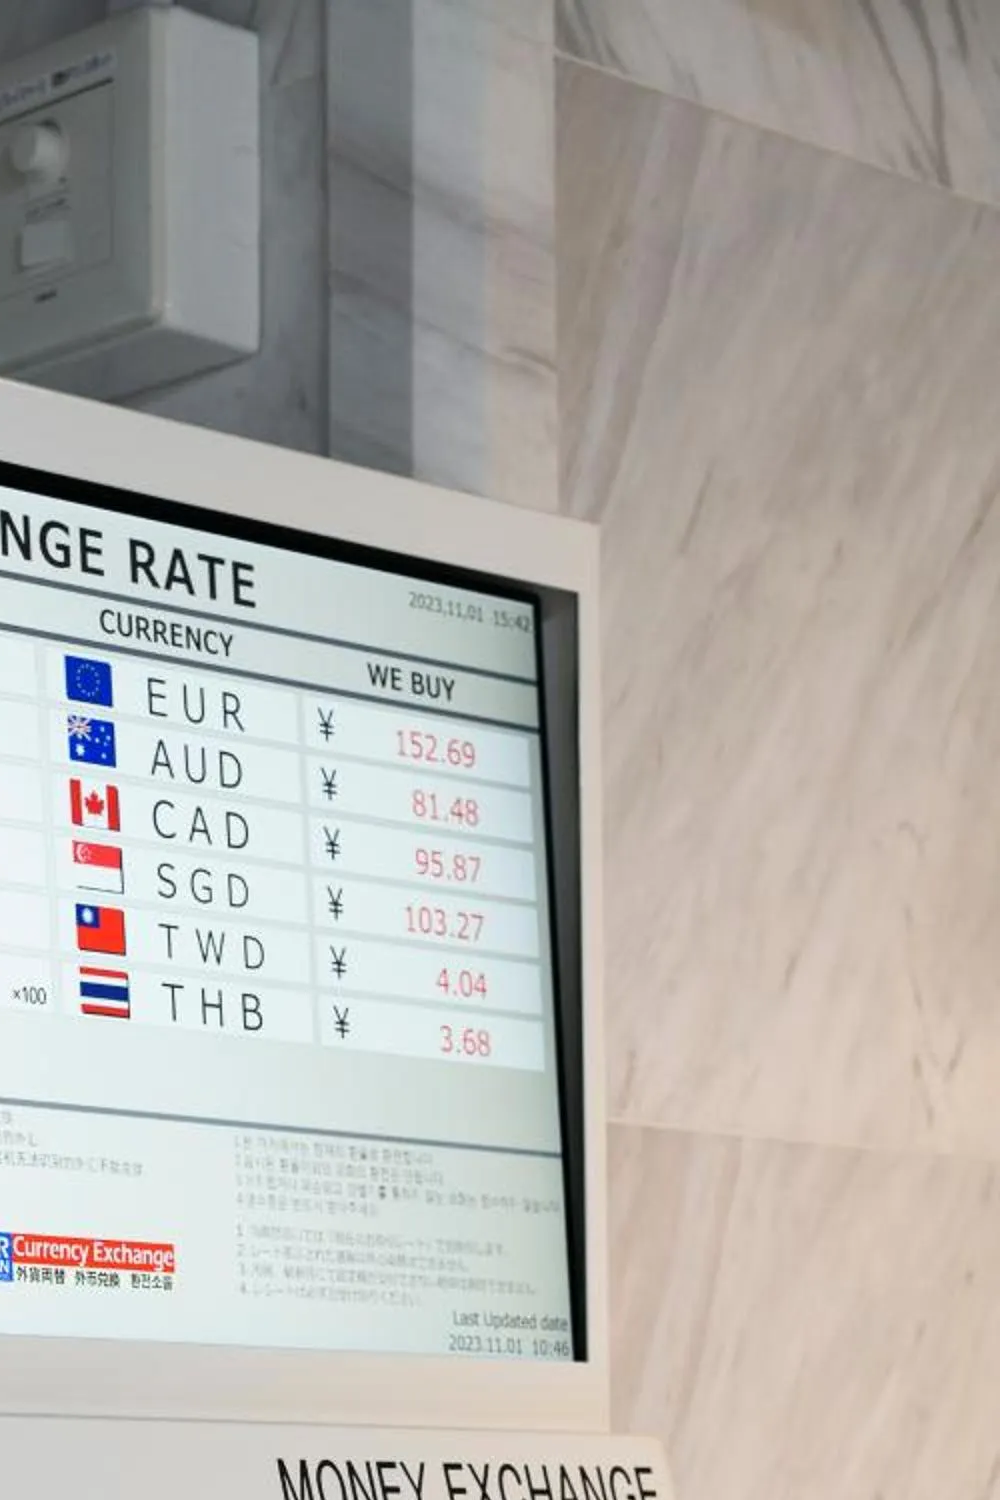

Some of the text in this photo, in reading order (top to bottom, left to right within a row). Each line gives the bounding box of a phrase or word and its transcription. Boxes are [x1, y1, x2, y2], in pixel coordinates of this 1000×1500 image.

[129, 538, 256, 608] RATE
[99, 609, 234, 657] CURRENCY
[367, 661, 455, 702] WE BUY
[147, 677, 246, 733] EUR
[396, 729, 476, 769] 152.69
[151, 739, 243, 790] AUD
[412, 790, 478, 828] 81.48
[153, 800, 248, 850] CAD
[415, 849, 481, 884] 95.87
[157, 863, 248, 909] SGD
[404, 906, 484, 942] 103.27
[159, 923, 265, 971] TWD
[436, 967, 488, 999] 4.04
[162, 982, 263, 1032] THB
[440, 1025, 491, 1057] 3.68
[13, 1236, 89, 1267] Currency
[93, 1242, 174, 1273] Exchange
[453, 1311, 568, 1331] Last Updated date
